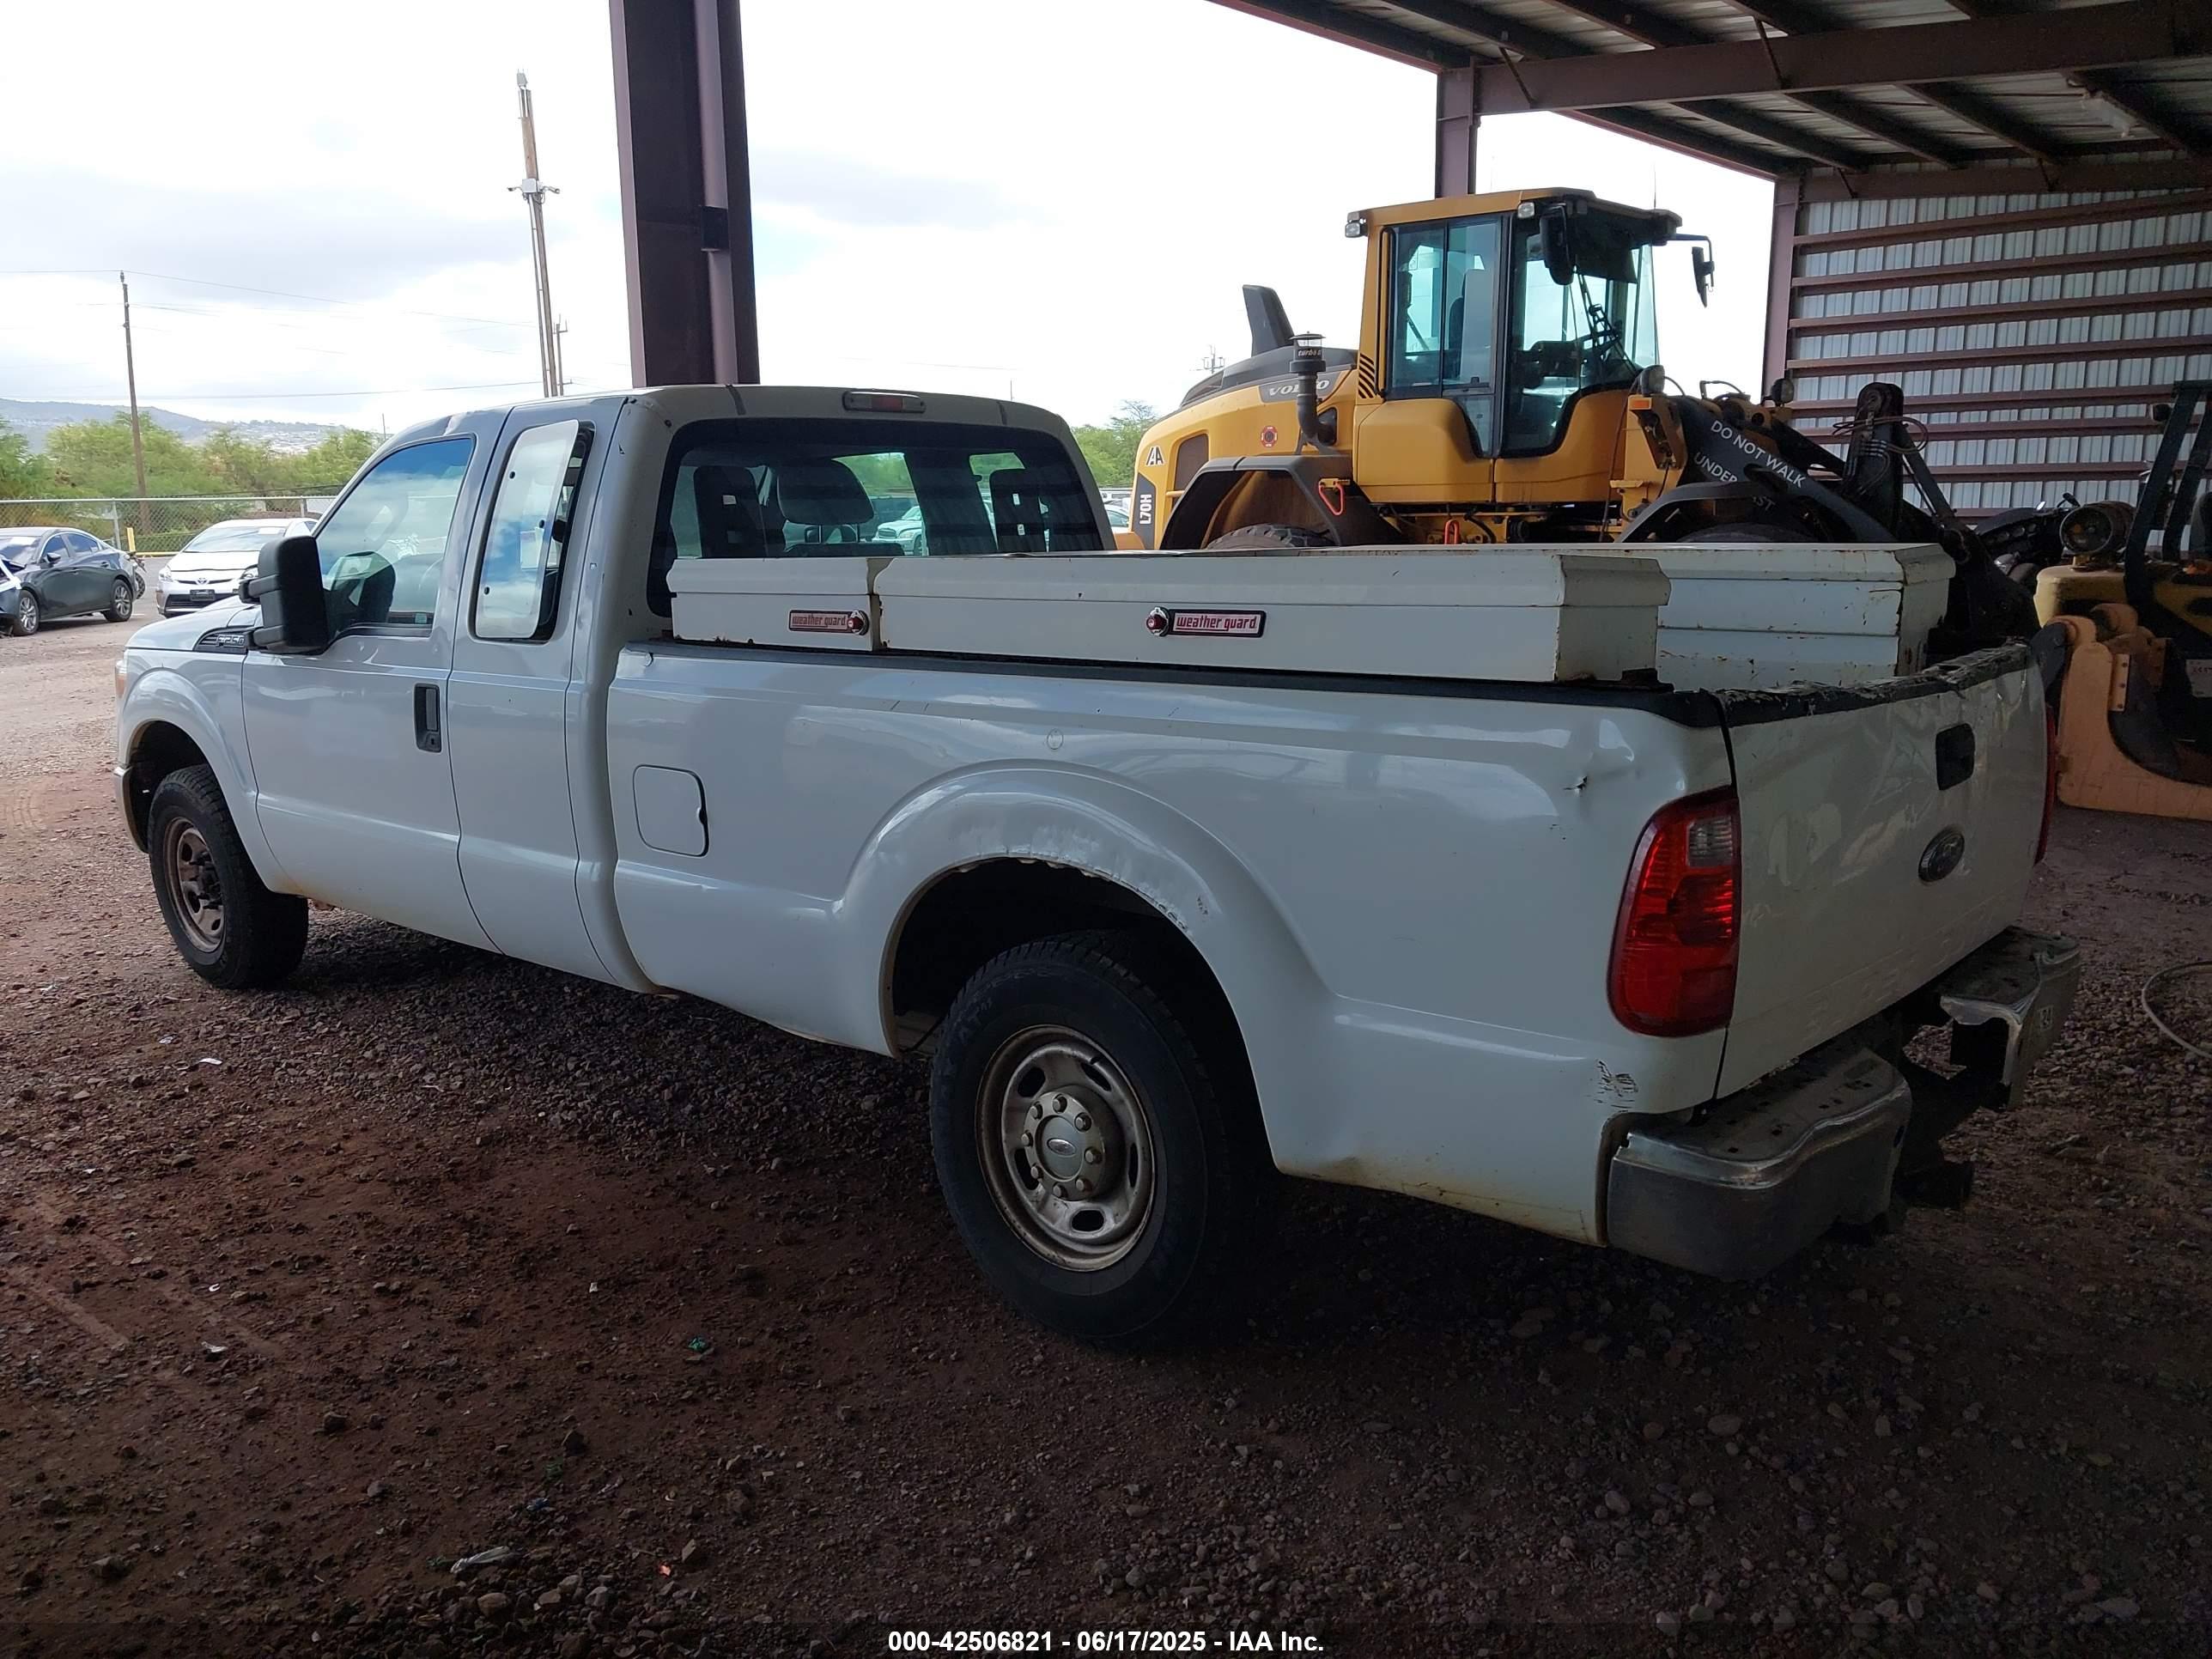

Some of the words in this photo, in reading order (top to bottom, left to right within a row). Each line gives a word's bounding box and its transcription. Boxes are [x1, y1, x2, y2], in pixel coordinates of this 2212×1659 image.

[1269, 380, 1330, 396] VOLO
[1711, 420, 1733, 439] DO
[1733, 434, 1766, 459] NOT
[1765, 454, 1807, 489] WALK
[1139, 494, 1152, 525] L70H
[793, 613, 823, 626] weather
[824, 616, 847, 628] guard
[1176, 615, 1223, 629] weather
[1224, 616, 1258, 631] guard
